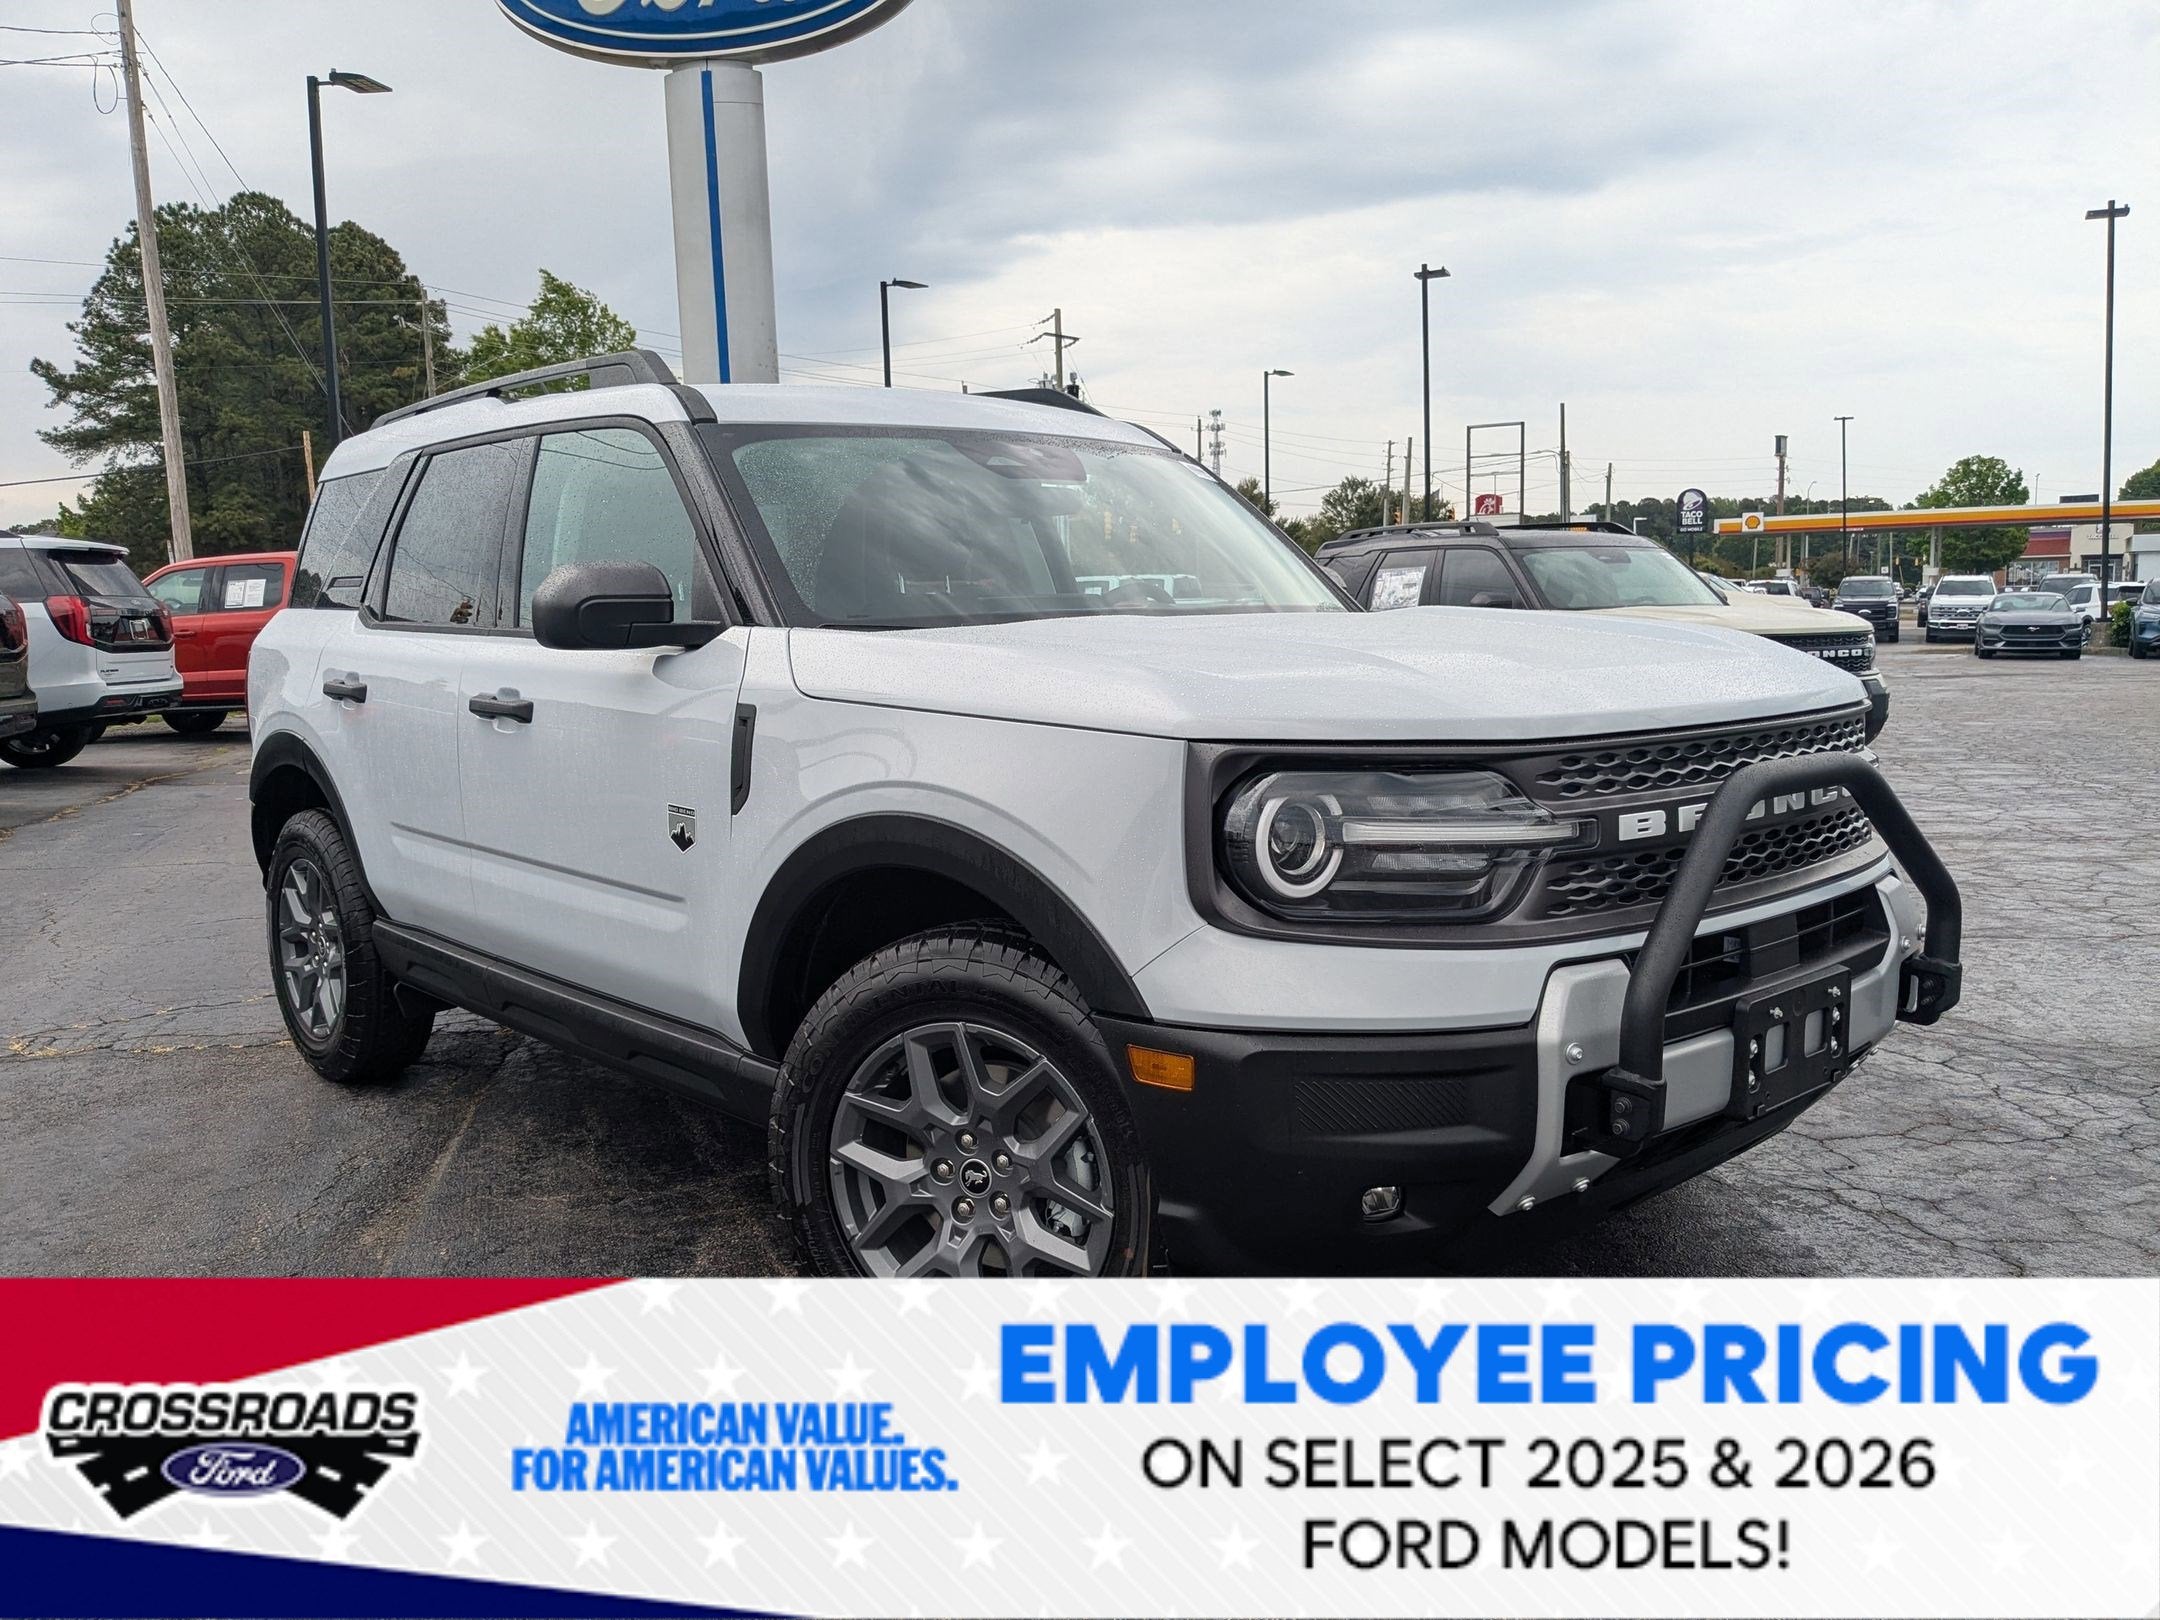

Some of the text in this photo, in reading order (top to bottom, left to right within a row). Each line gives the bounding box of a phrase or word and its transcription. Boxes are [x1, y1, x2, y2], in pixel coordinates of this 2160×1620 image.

[1680, 510, 1703, 518] TACO
[1806, 648, 1862, 658] ONCO
[1618, 783, 1852, 840] BNC
